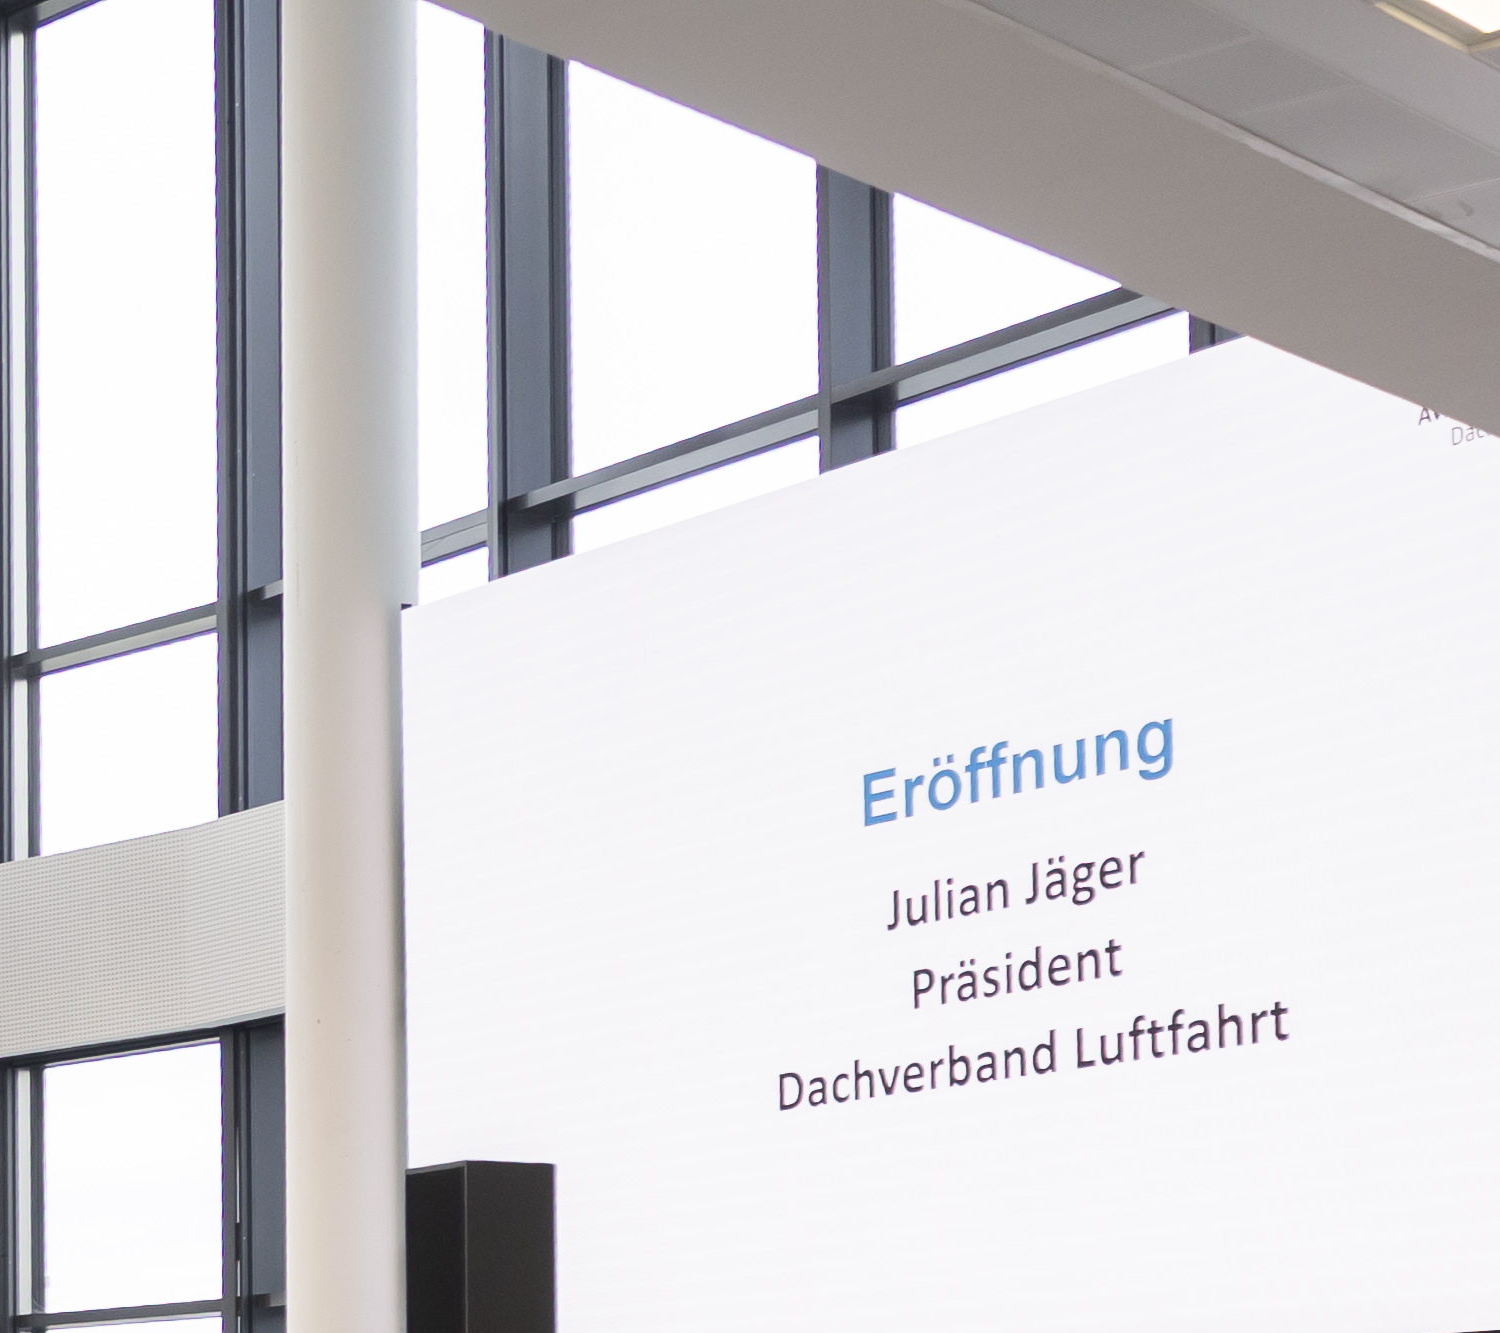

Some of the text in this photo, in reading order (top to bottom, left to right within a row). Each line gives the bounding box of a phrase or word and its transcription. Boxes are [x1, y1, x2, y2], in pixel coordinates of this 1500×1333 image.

[864, 719, 1173, 827] Eröffnung
[888, 852, 1144, 930] Julian Jäger
[914, 939, 1121, 1009] Präsident
[779, 1002, 1288, 1111] Dachverband Luftfahrt
